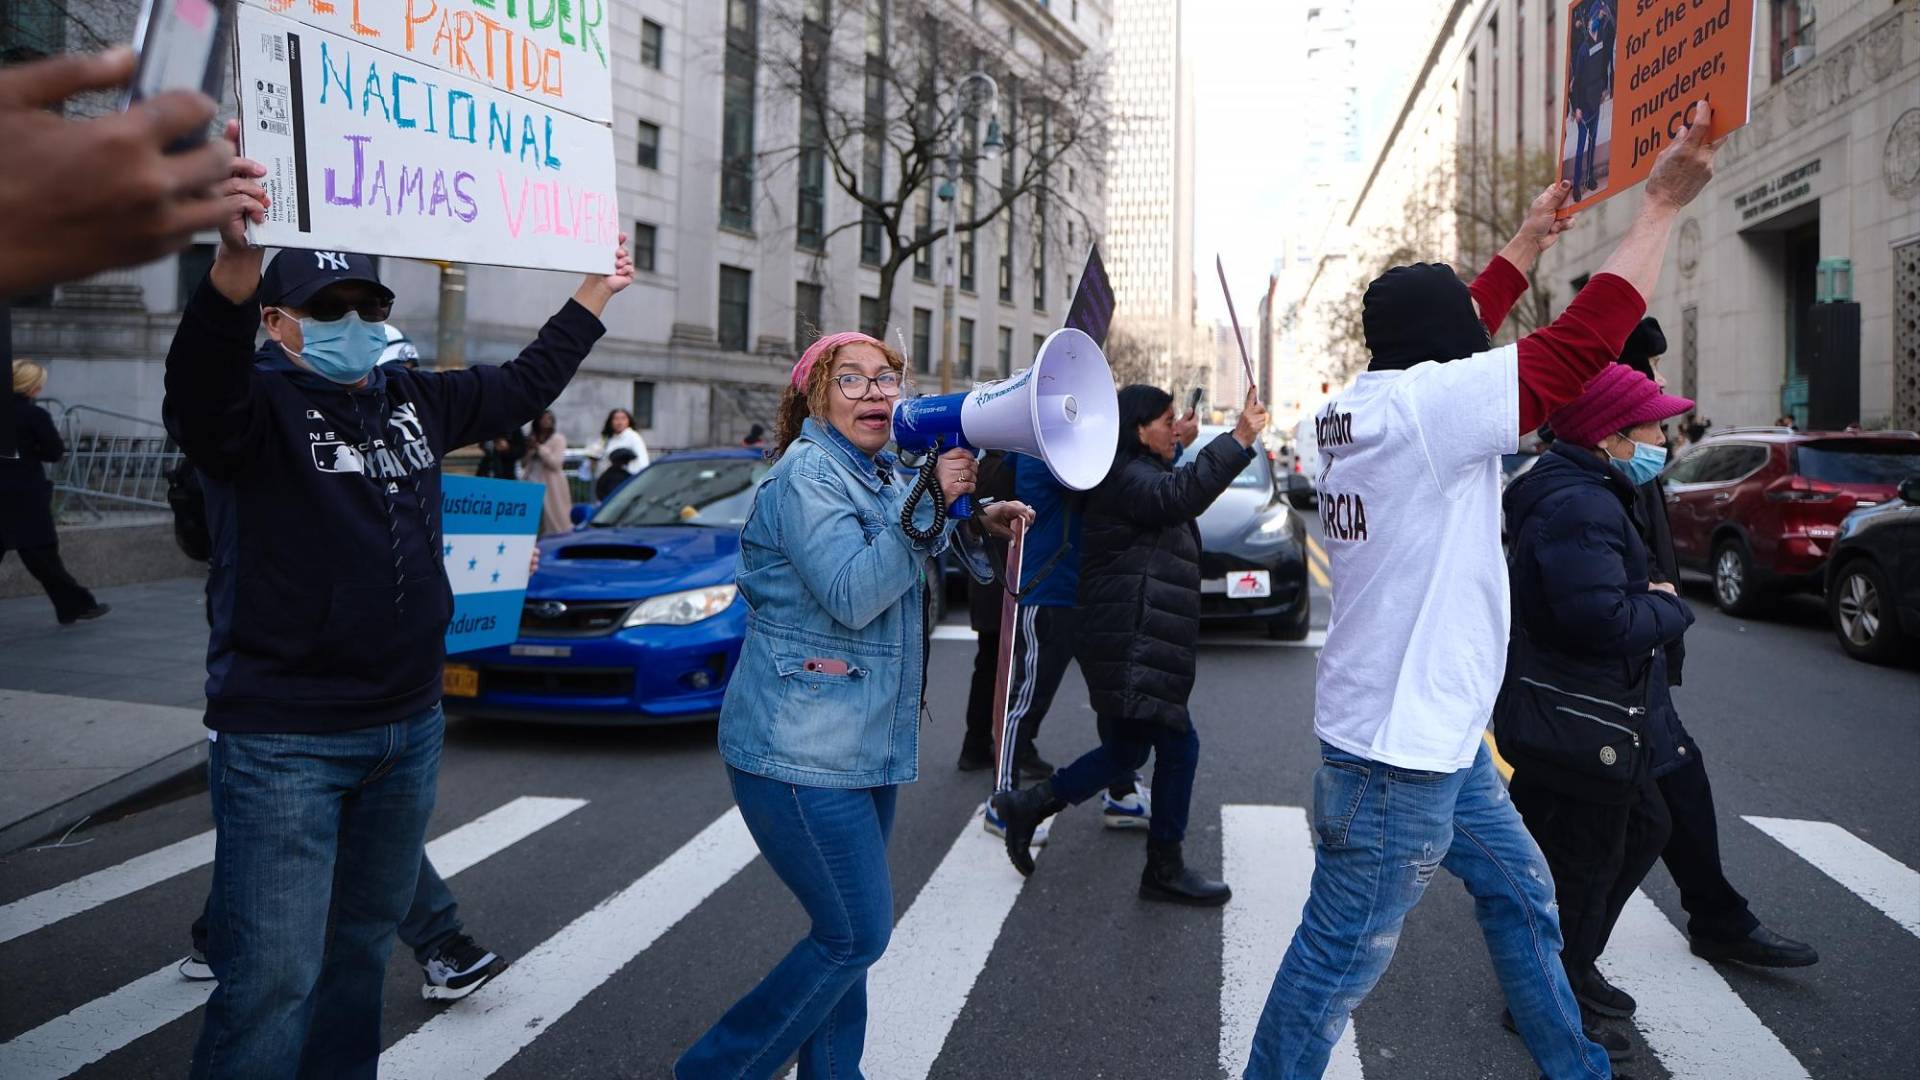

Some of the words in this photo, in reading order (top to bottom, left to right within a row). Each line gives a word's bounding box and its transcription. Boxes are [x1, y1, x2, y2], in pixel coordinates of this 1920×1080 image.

[402, 0, 564, 98] PARTIDO
[472, 0, 607, 69] DER
[1625, 28, 1651, 60] for
[1655, 2, 1687, 37] the
[1630, 37, 1688, 91] dealer
[1692, 0, 1731, 49] and
[319, 40, 562, 171] NACIONAL
[1631, 51, 1726, 128] murderer,
[324, 134, 479, 223] JAMAS
[1631, 126, 1661, 168] Joh
[494, 500, 528, 522] para
[446, 612, 497, 636] nduras
